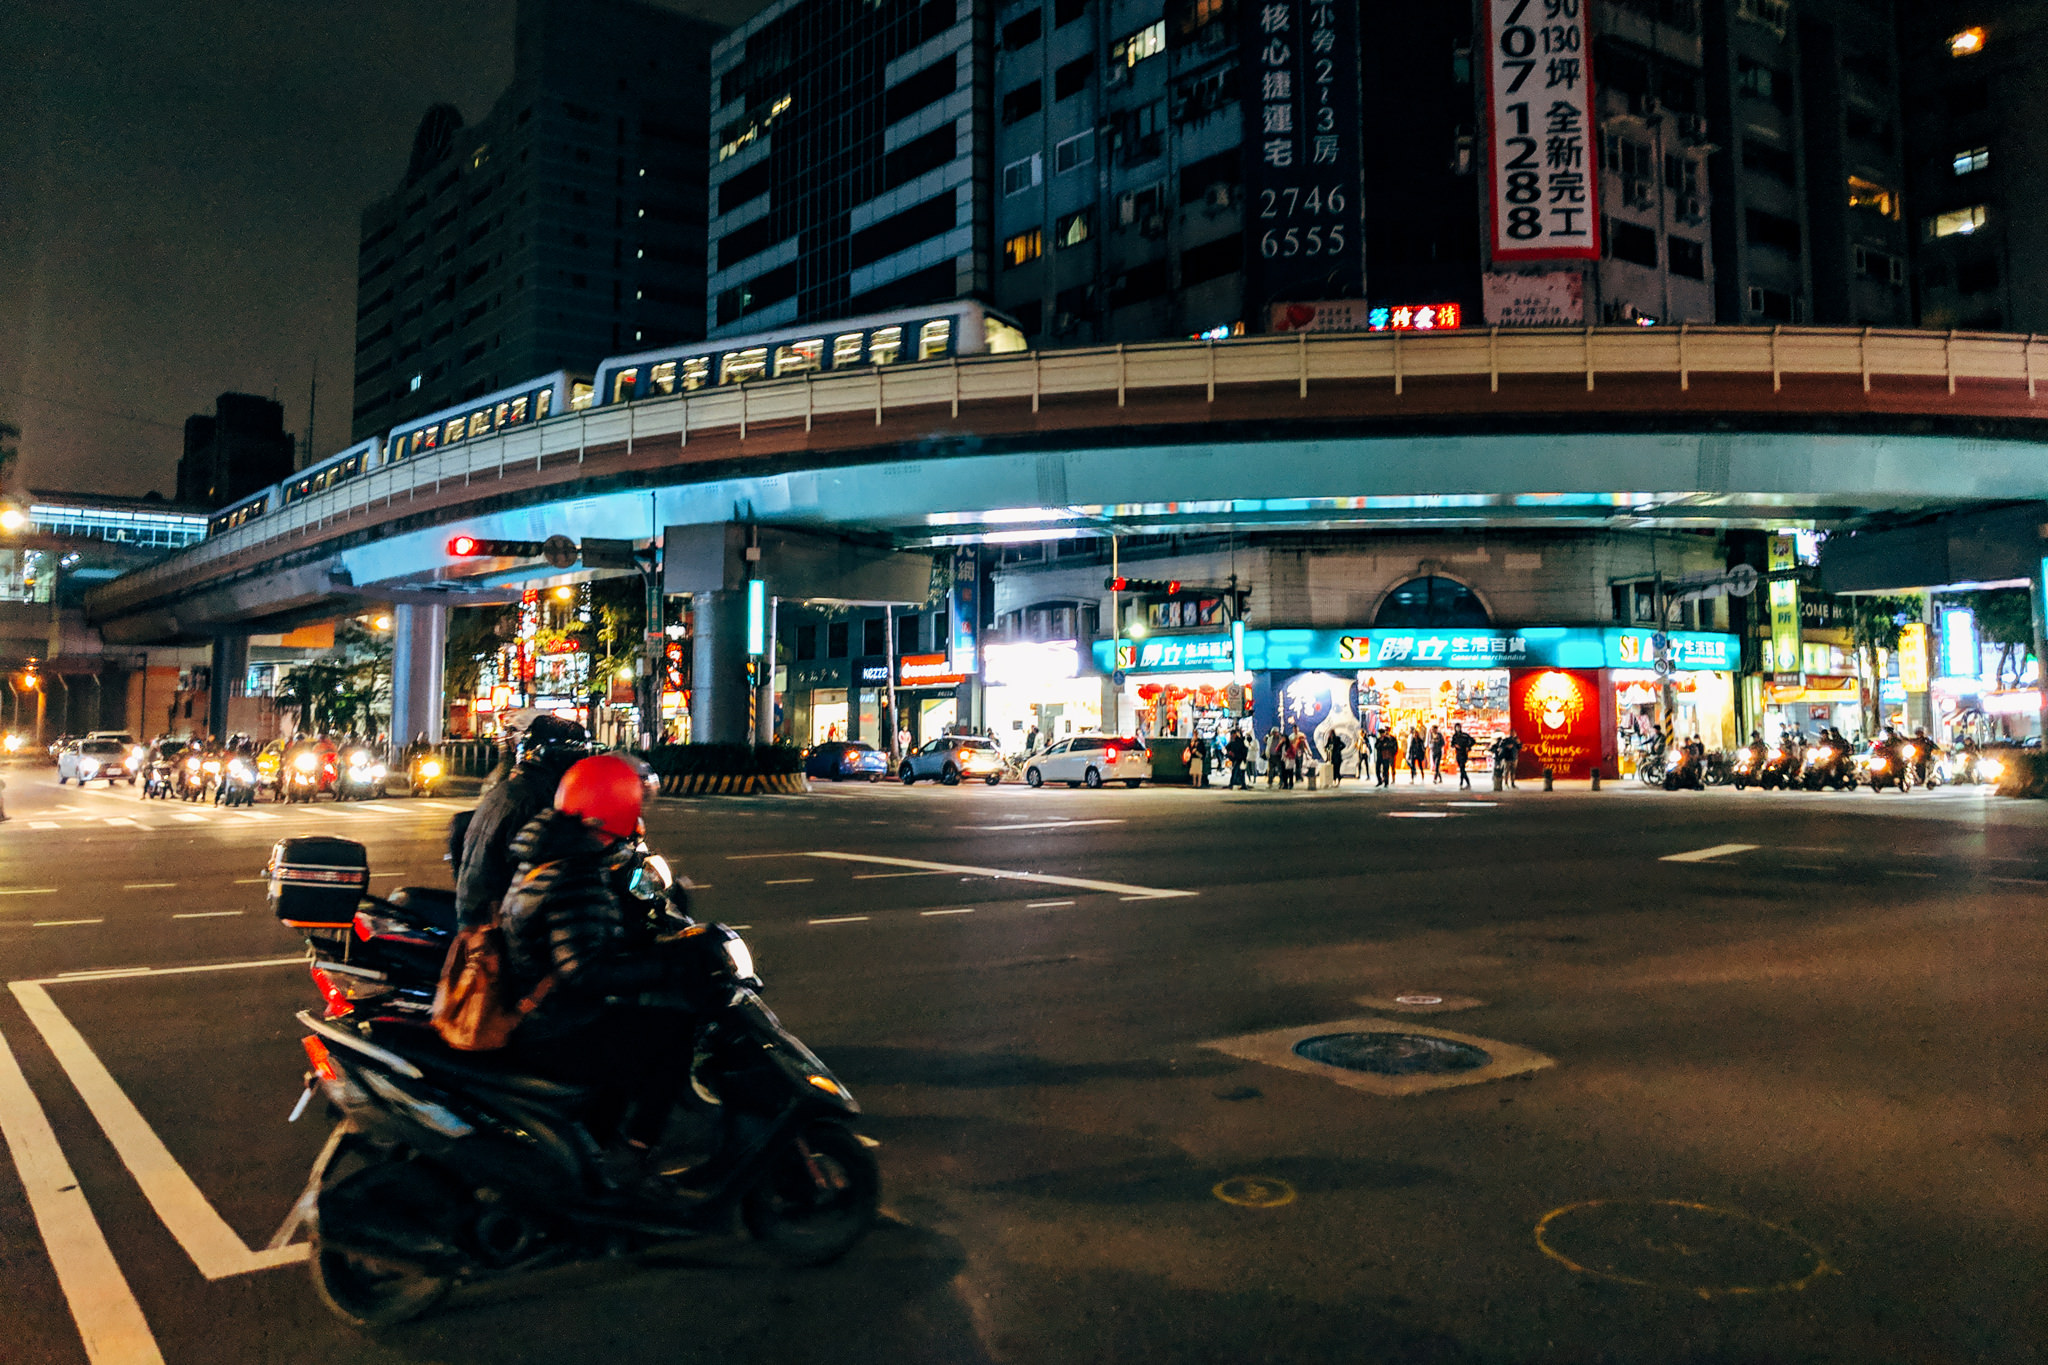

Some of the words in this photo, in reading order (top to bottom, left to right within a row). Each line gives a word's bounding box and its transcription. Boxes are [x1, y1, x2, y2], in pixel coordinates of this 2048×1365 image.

[1261, 183, 1345, 220] 2746
[1260, 224, 1345, 259] 6555
[1340, 635, 1369, 663] SL
[1377, 636, 1449, 661] 勝立
[1451, 637, 1527, 652] 生活百貨
[1534, 741, 1583, 757] Chinese
